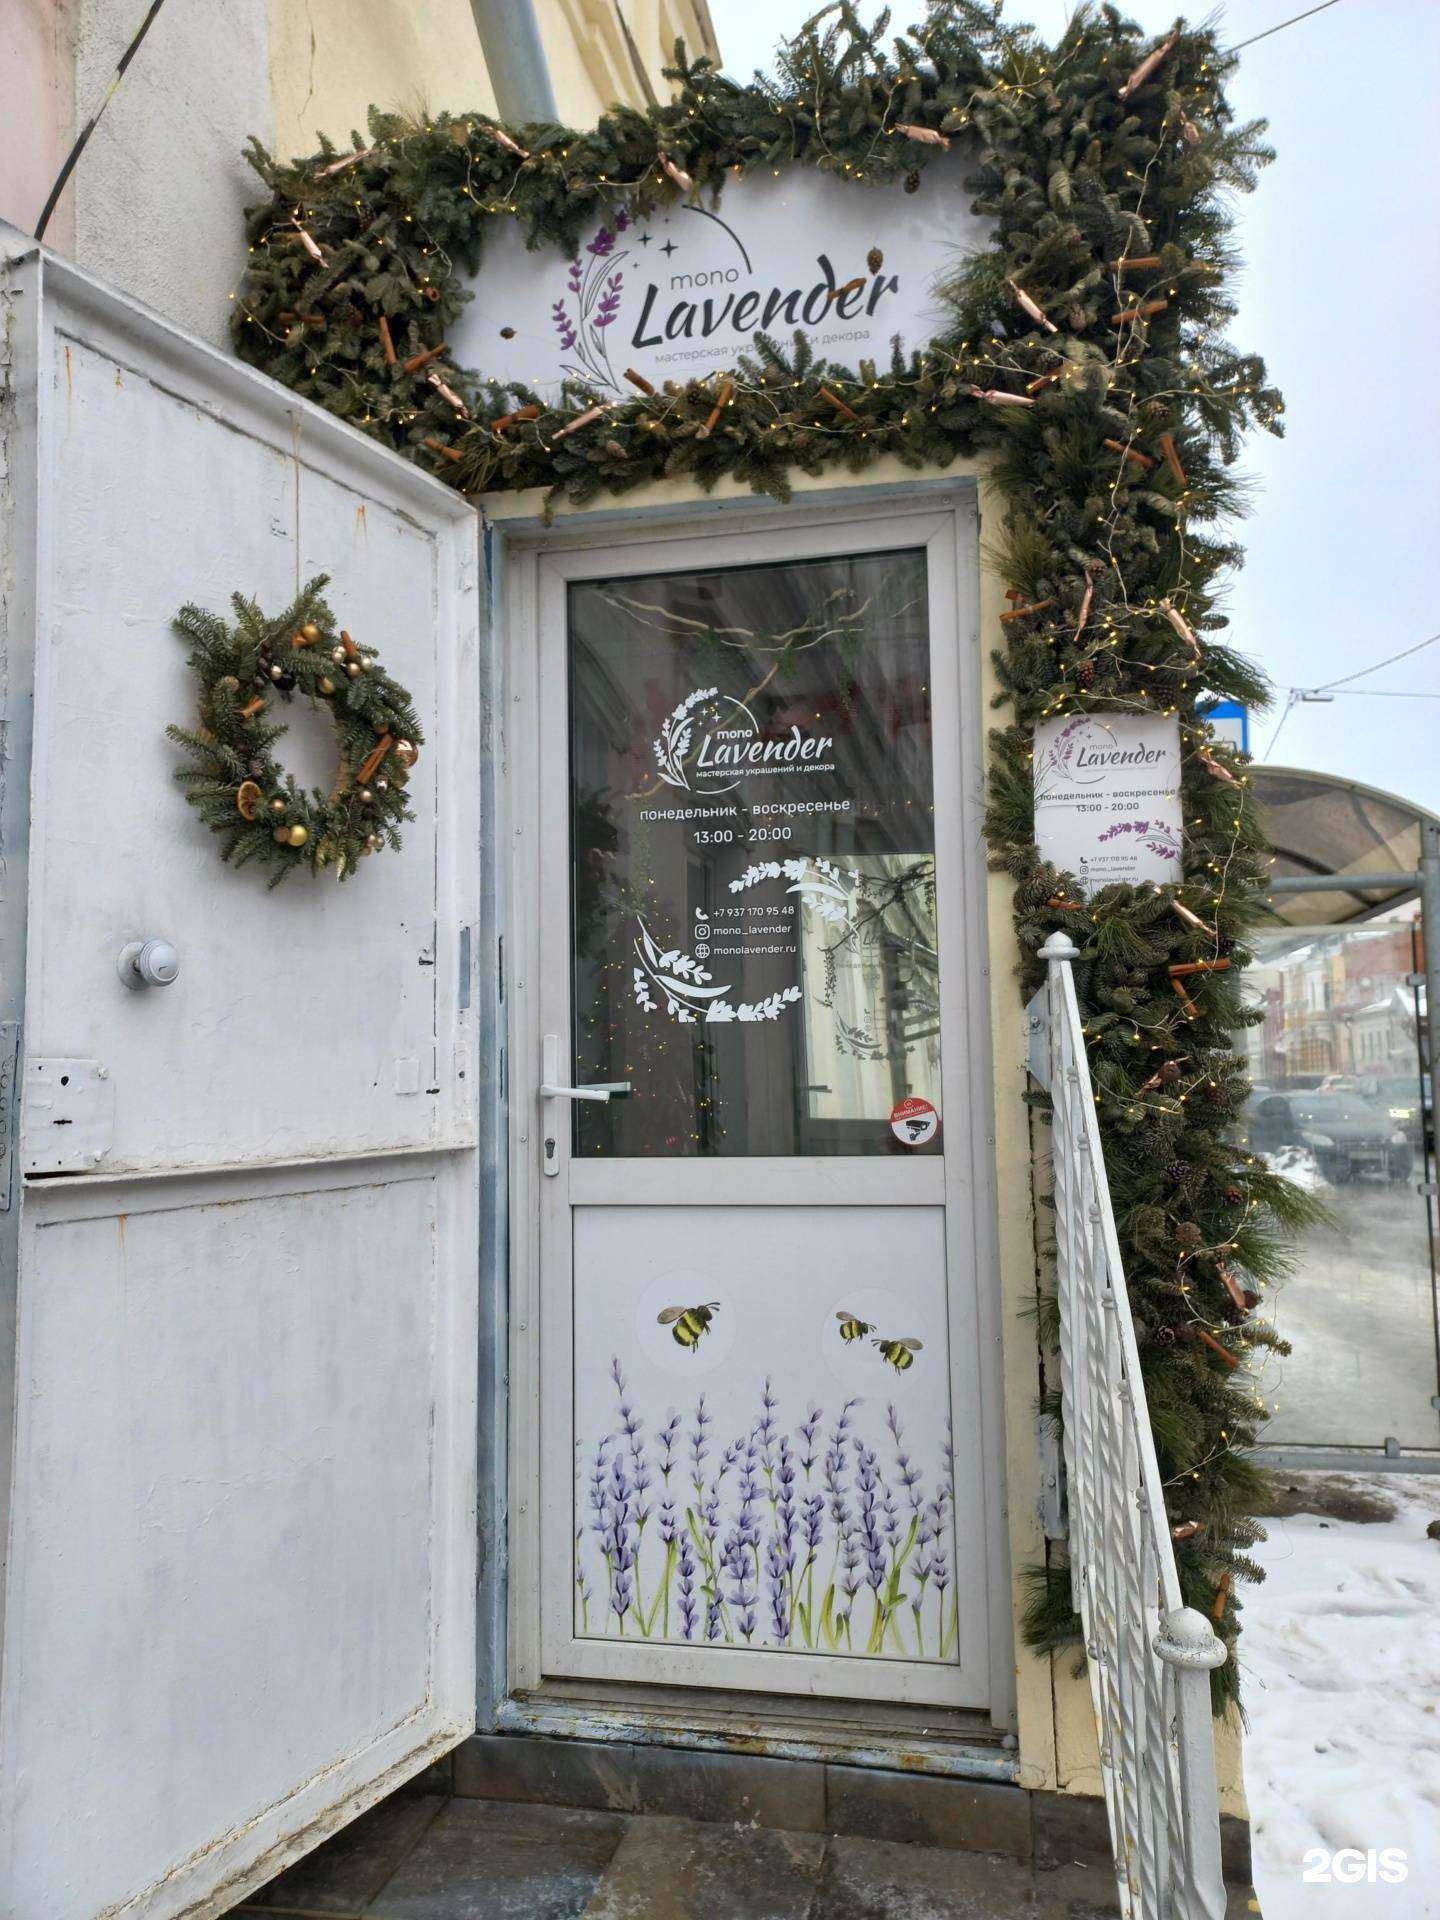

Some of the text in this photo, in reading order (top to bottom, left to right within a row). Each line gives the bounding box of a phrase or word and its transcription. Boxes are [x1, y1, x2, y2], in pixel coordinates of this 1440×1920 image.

[670, 268, 739, 290] mono
[631, 254, 899, 349] Lavender
[654, 346, 729, 363] мастерская
[822, 329, 871, 347] декора
[716, 729, 754, 740] mono
[696, 724, 833, 768] Lavender
[1089, 743, 1114, 751] mono
[1076, 742, 1167, 768] Lavender
[696, 762, 836, 778] мастерская украшений и декора
[1040, 791, 1104, 801] понедельник
[1112, 788, 1176, 799] воскресенье
[640, 805, 738, 821] понедельник
[752, 799, 851, 816] воскресенье
[1077, 804, 1102, 812] 13:00
[1111, 802, 1140, 811] 20:00
[693, 829, 734, 844] 13:00
[748, 826, 792, 842] 20:00
[713, 905, 795, 918] +7 937 170 95 48
[713, 924, 792, 936] mono_lavender
[713, 944, 797, 955] monolavender.ru
